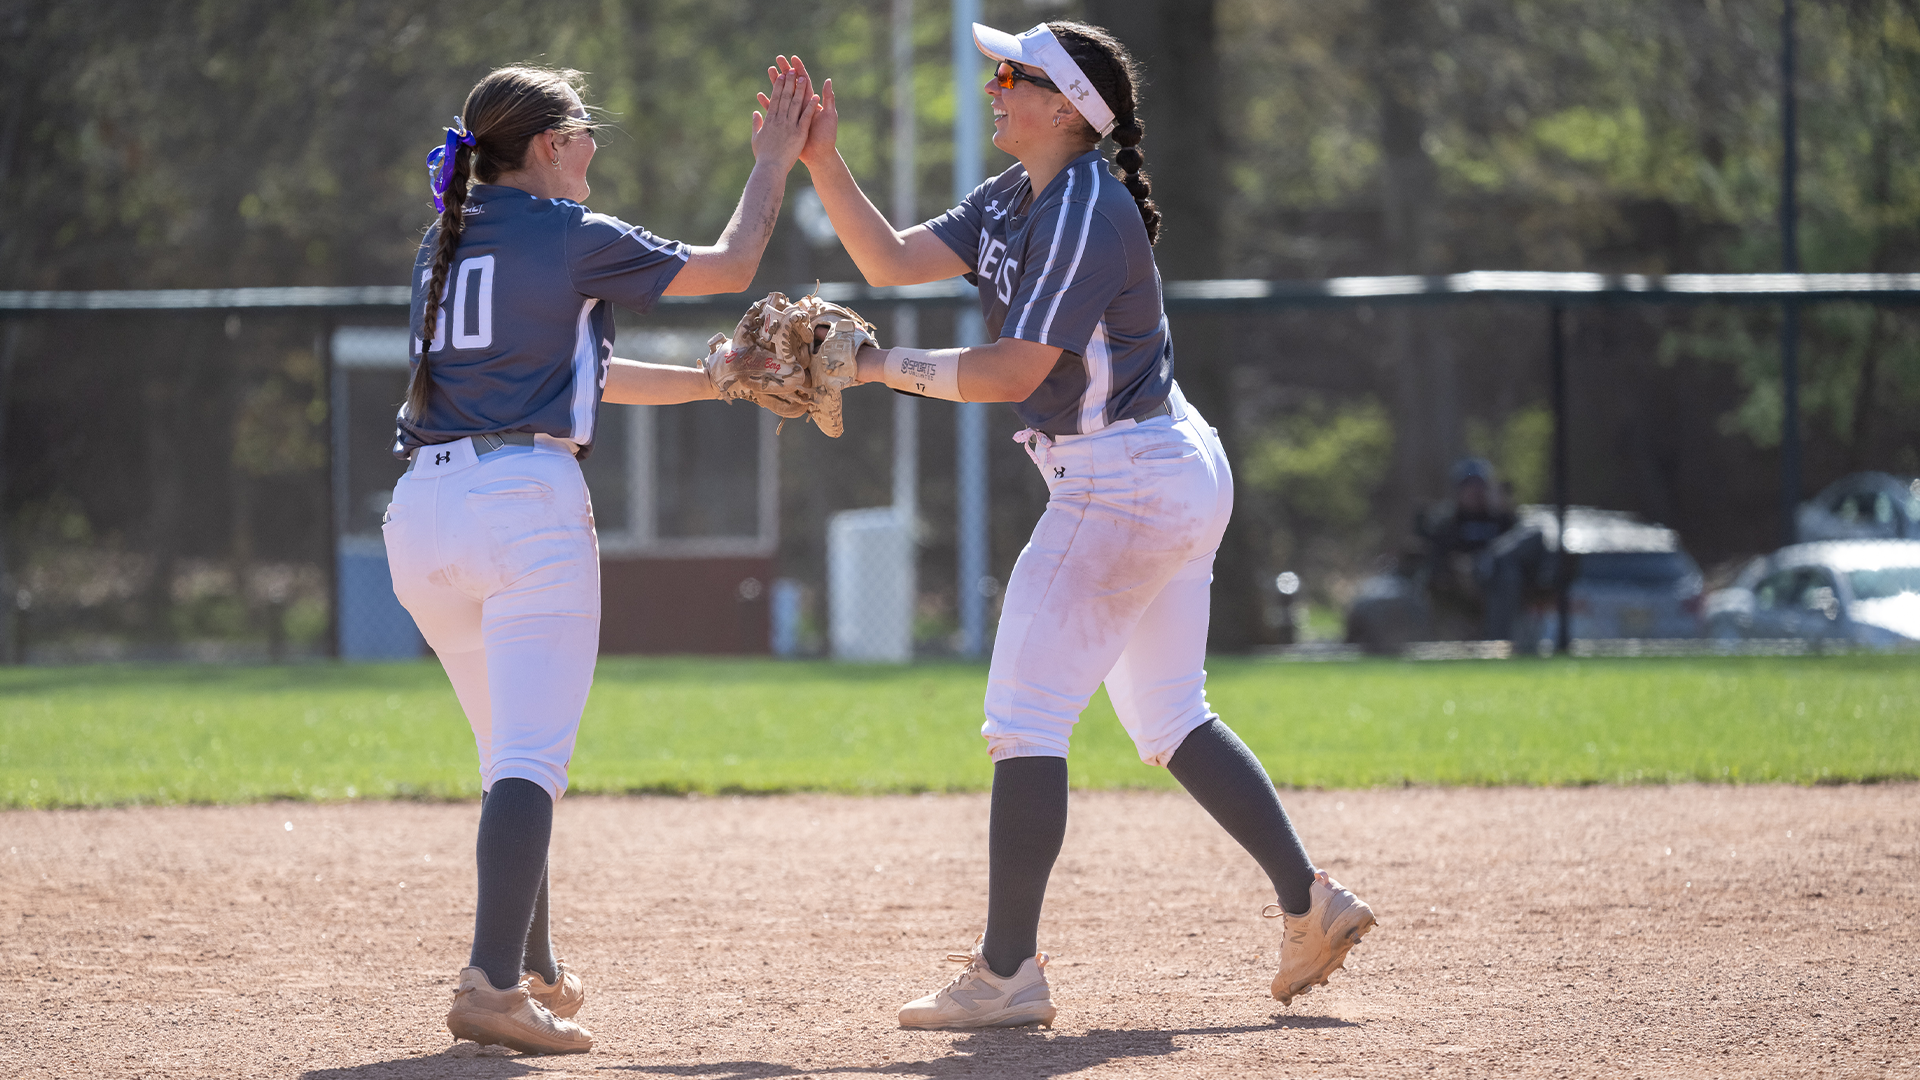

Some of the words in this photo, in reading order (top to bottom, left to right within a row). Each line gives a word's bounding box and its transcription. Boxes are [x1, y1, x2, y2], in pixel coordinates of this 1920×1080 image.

[764, 357, 781, 374] Berg
[907, 359, 936, 376] SPORTS
[916, 382, 926, 393] 17
